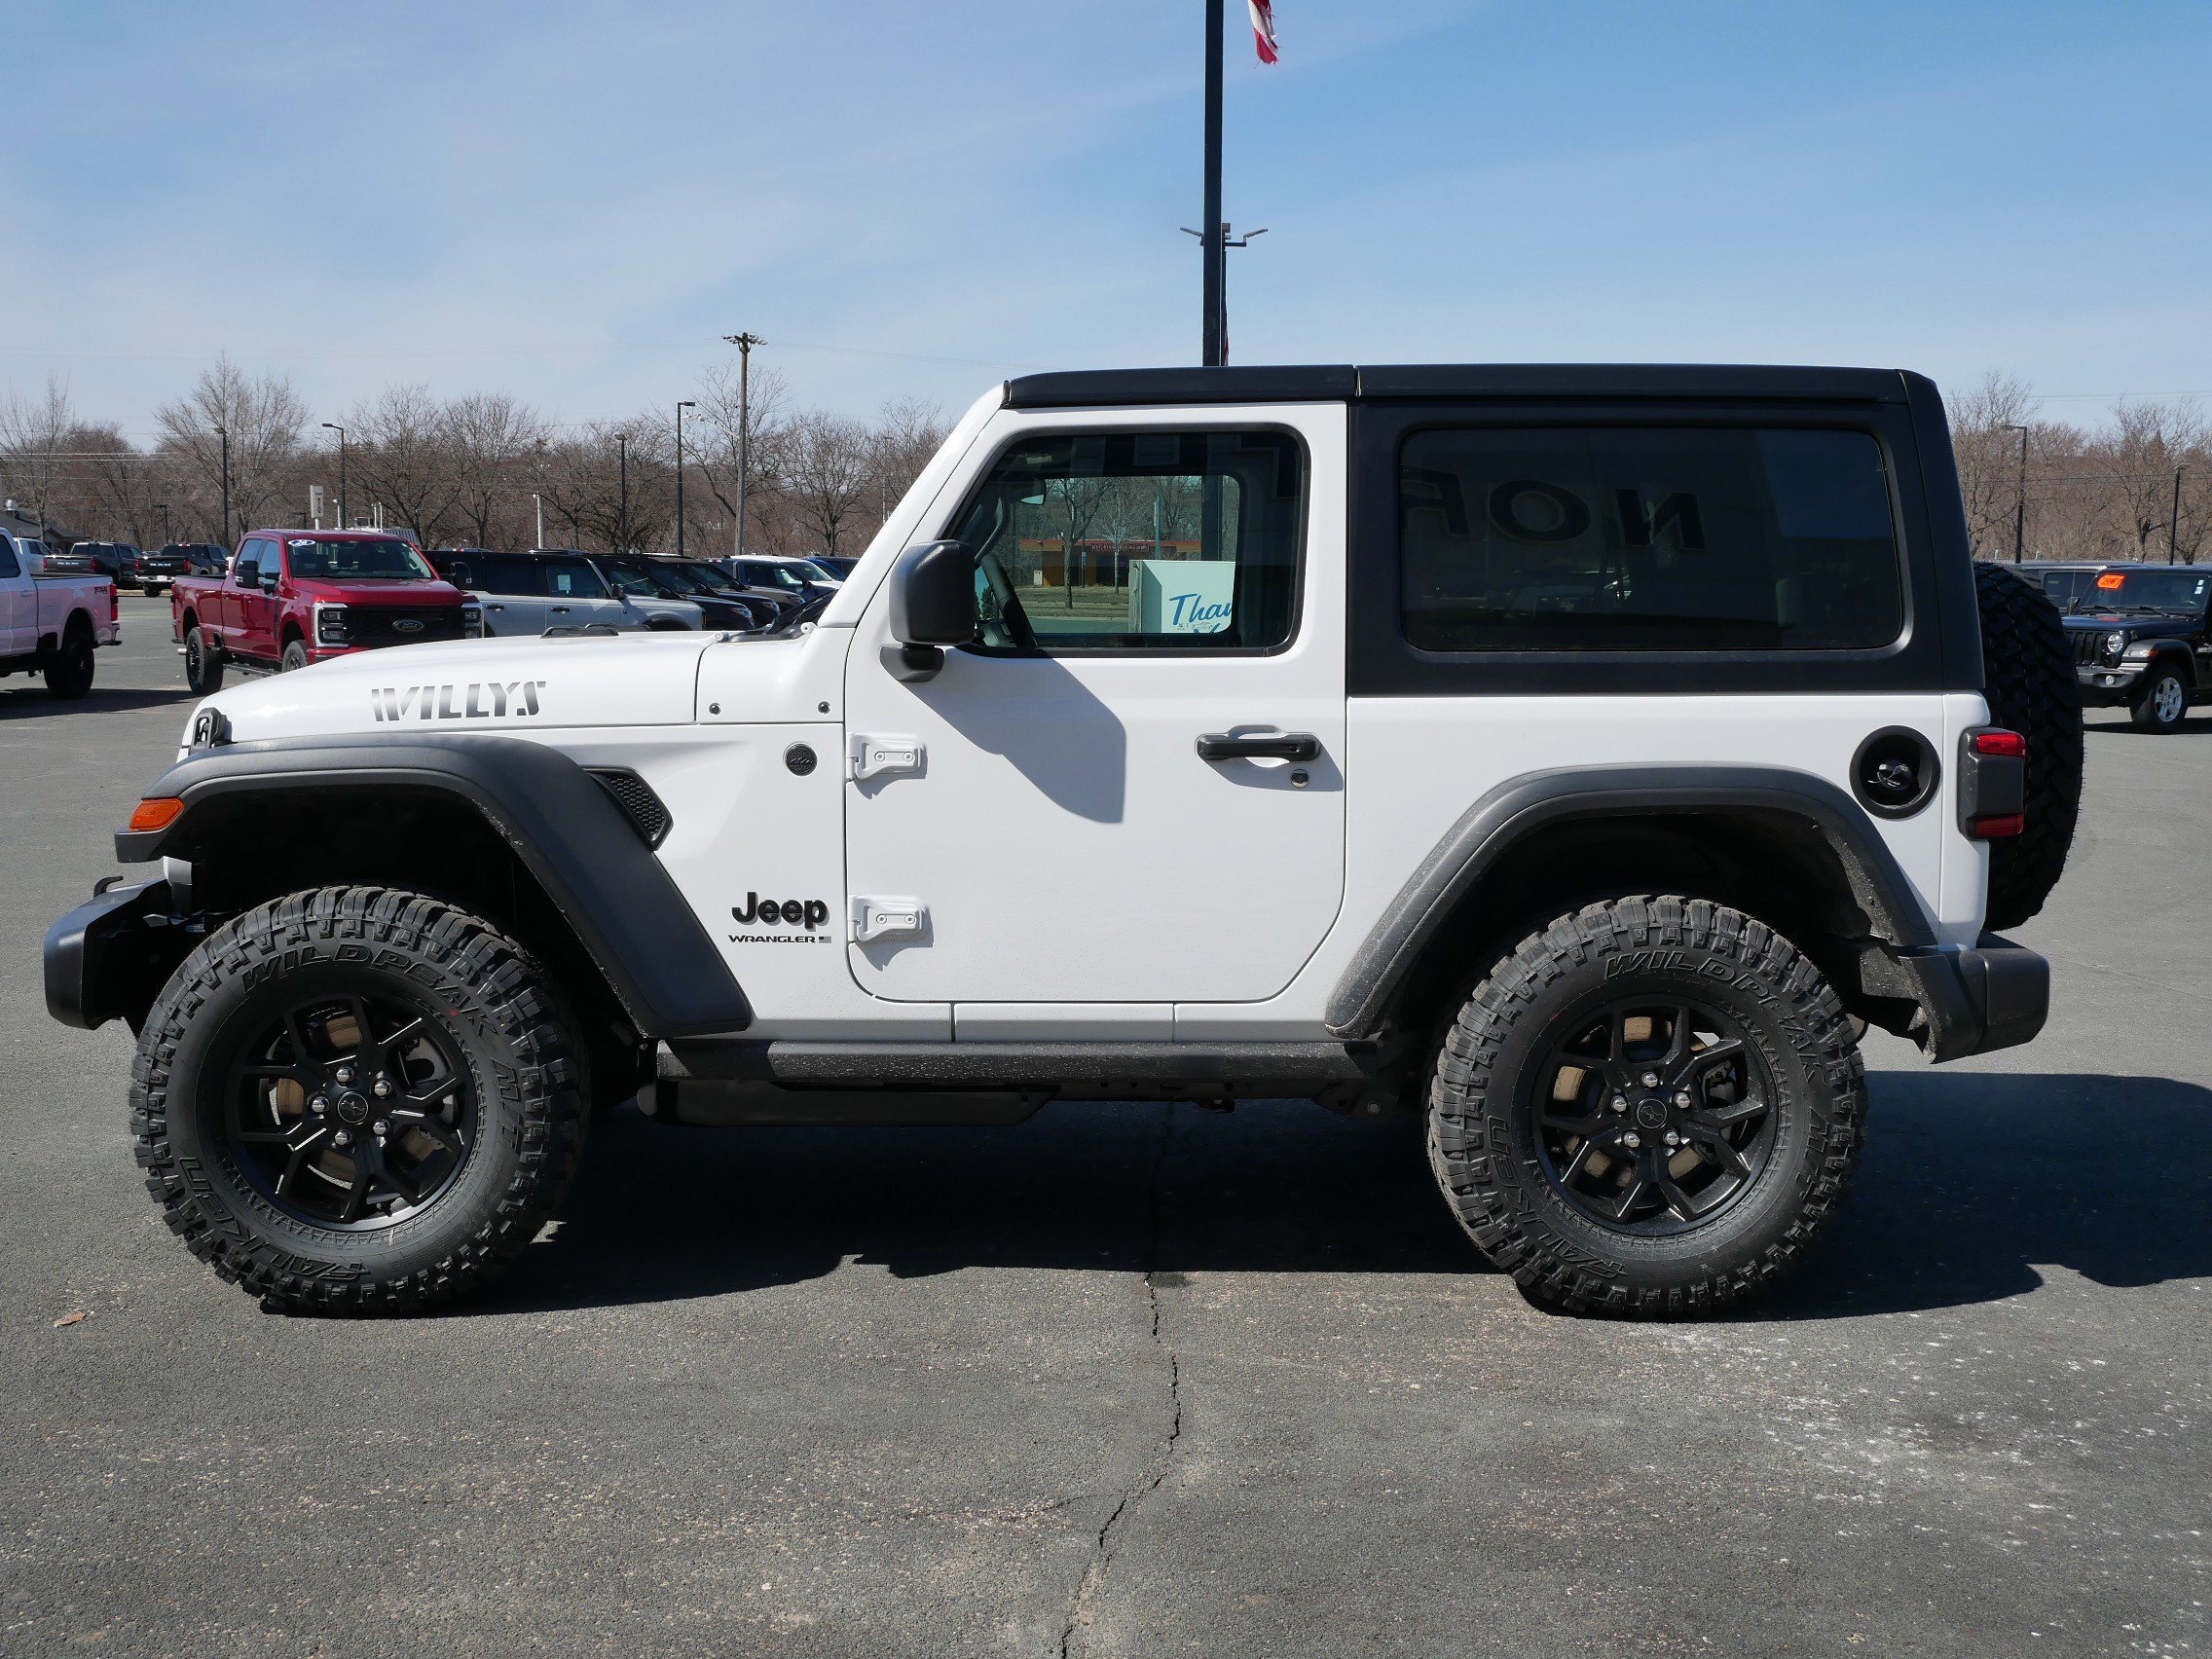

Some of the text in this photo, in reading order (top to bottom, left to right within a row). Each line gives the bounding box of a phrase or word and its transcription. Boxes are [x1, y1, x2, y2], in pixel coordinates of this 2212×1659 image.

[371, 681, 547, 722] WILLYS
[731, 891, 829, 931] Jeep
[727, 934, 816, 943] WRANGLER
[240, 943, 498, 1037] WILDPEAK
[1604, 949, 1827, 1088] WILDPEAK
